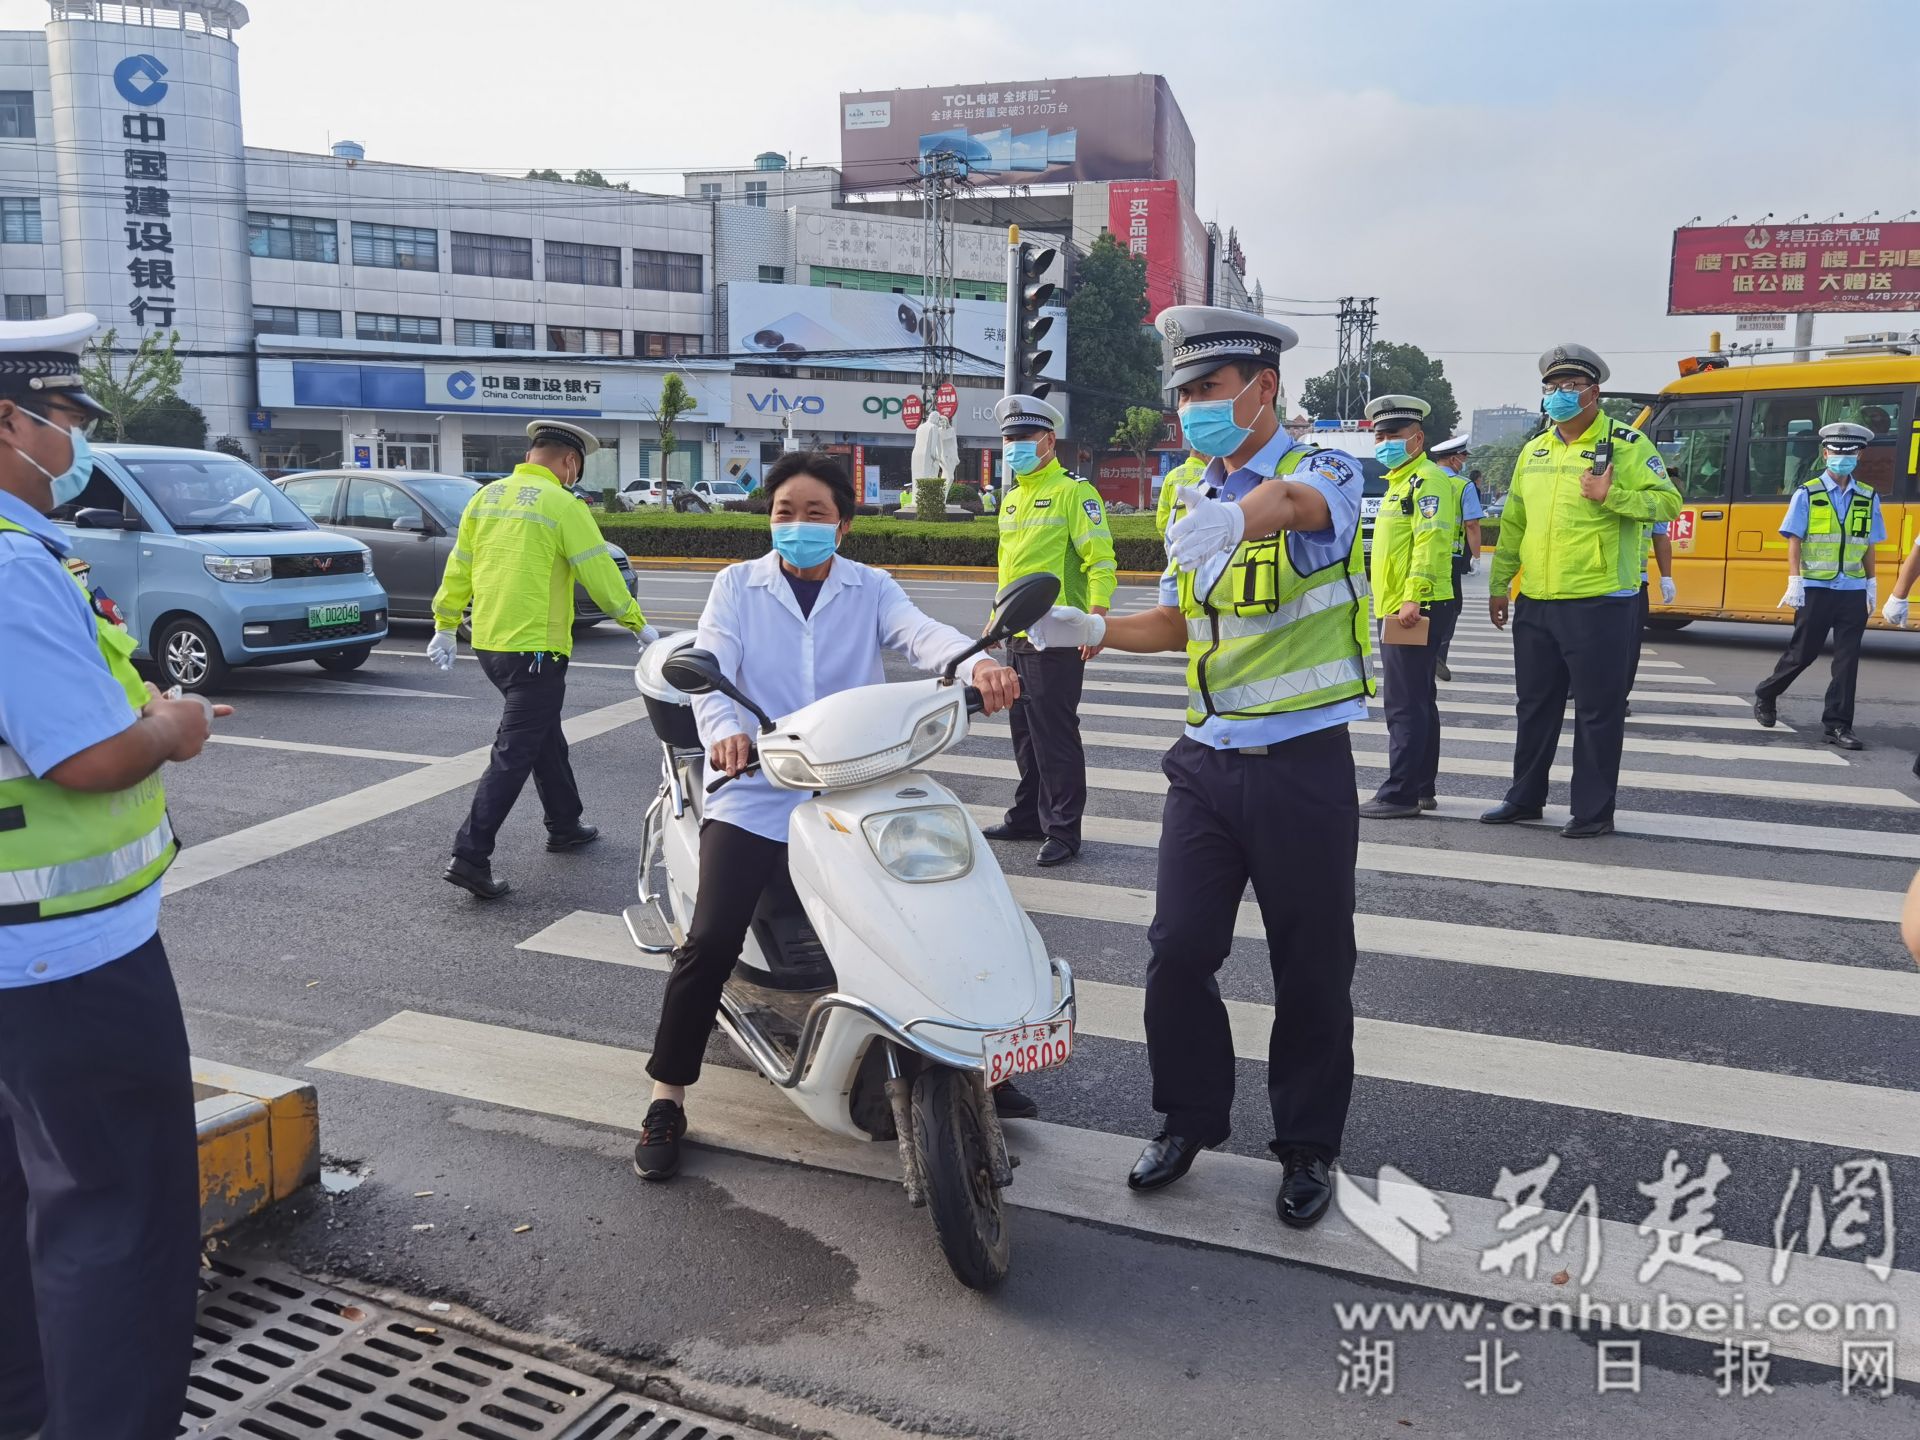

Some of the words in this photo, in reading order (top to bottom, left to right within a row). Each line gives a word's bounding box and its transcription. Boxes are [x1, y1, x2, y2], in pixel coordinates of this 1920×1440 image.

[943, 92, 999, 107] TCL电视
[931, 102, 1069, 121] 全球年出货量突破3120万台
[122, 113, 177, 328] 中国建设银行
[1129, 198, 1149, 255] 买品质
[1776, 228, 1880, 243] 孝昌五金汽配城
[1695, 252, 1807, 271] 楼下金铺
[1733, 273, 1805, 293] 低公摊
[1819, 272, 1893, 291] 大赠送
[482, 375, 602, 395] 中国建设银行
[482, 390, 508, 399] China
[511, 391, 563, 401] Construction
[565, 393, 587, 402] Bank
[747, 387, 825, 415] vivo
[484, 482, 543, 508] 警察
[991, 1039, 1067, 1083] 829809
